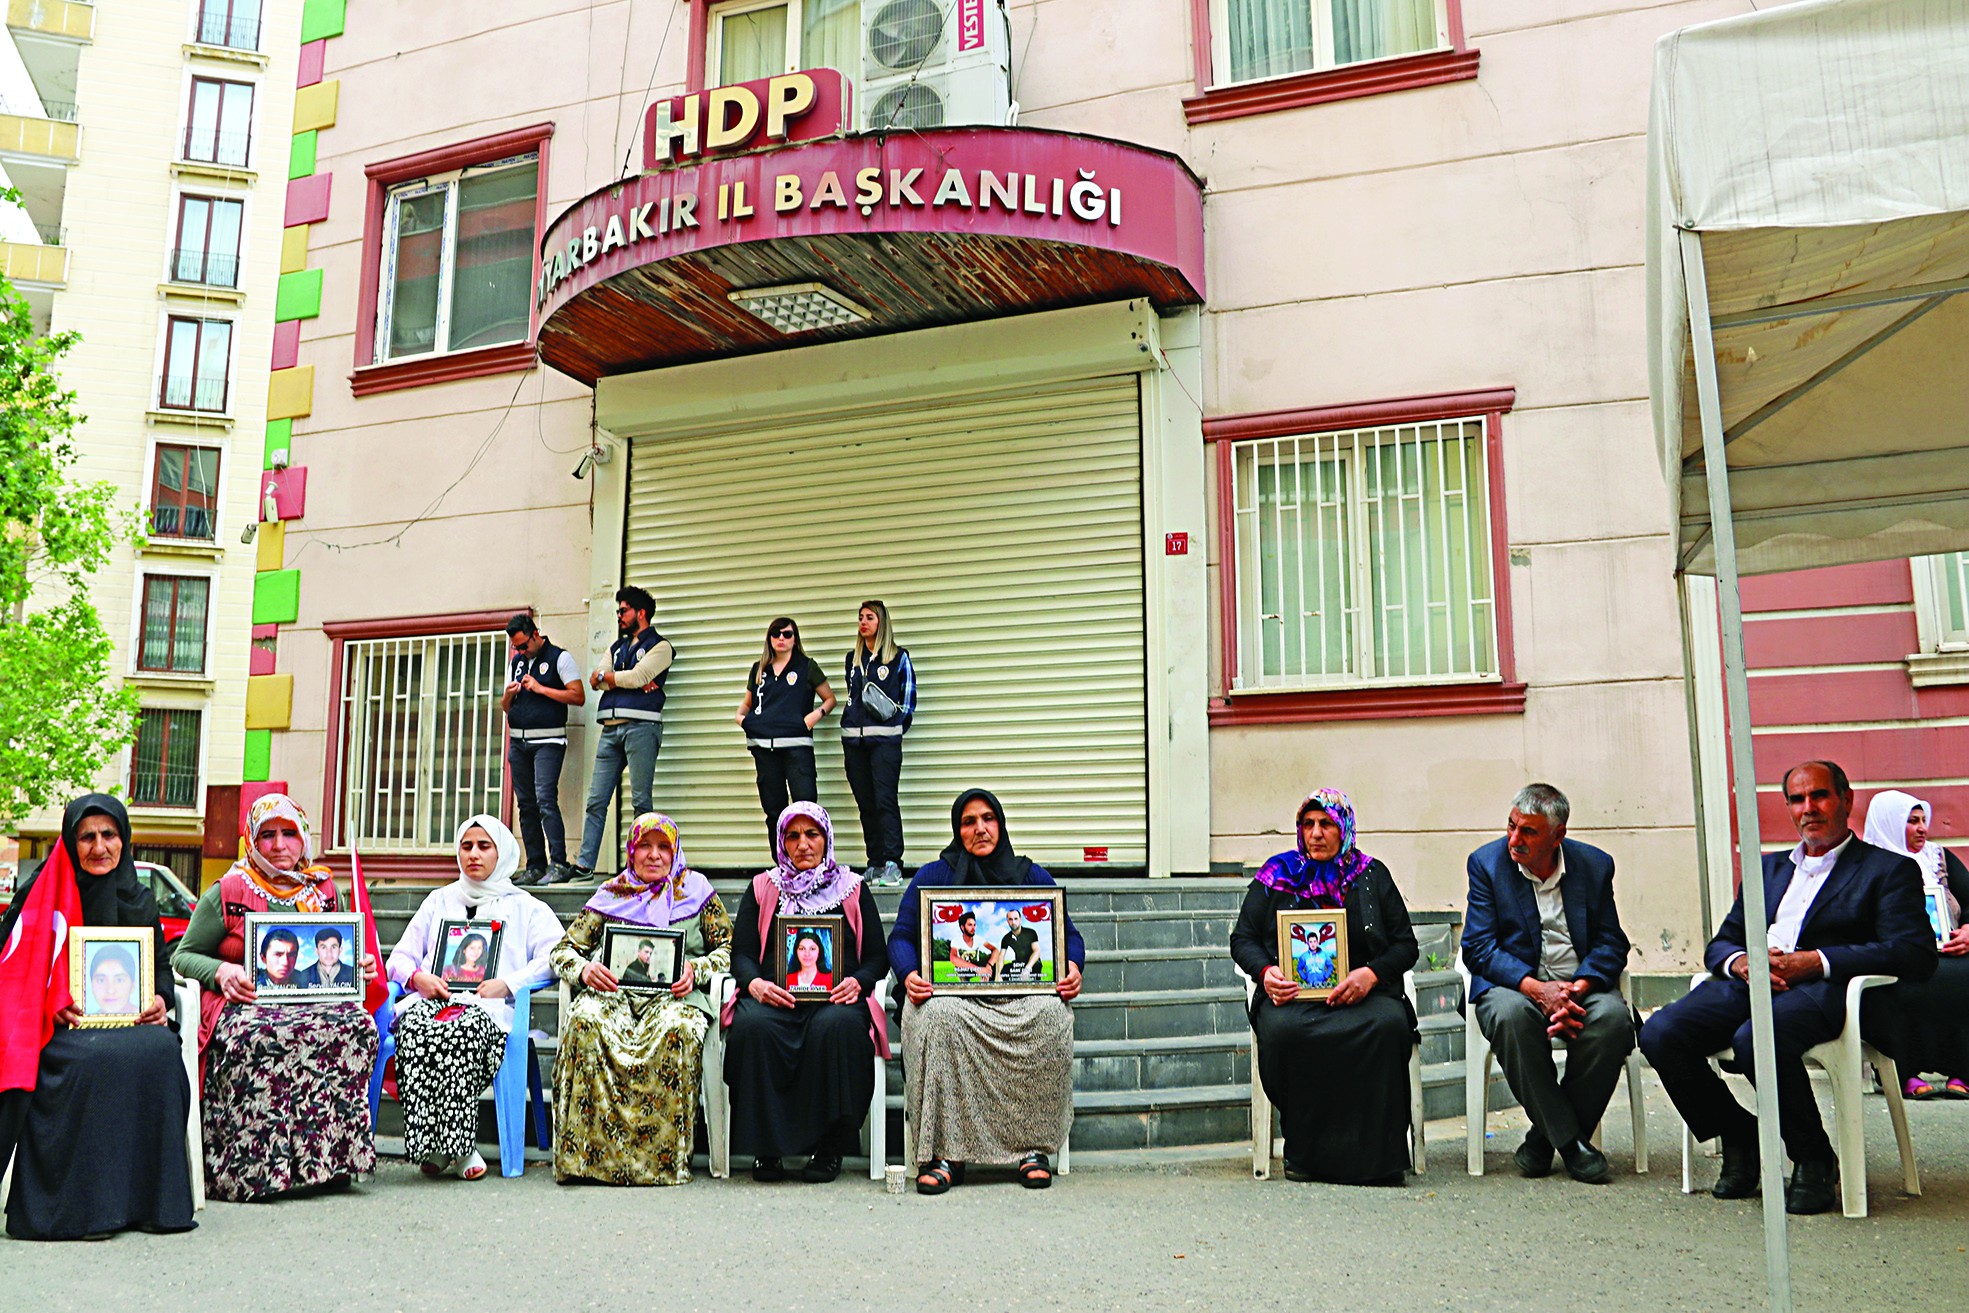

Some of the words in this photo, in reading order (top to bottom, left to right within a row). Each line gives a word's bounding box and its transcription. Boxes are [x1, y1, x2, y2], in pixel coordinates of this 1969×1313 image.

[655, 73, 817, 162] HDP
[775, 167, 1121, 226] BAŞKANLIĞI
[1172, 541, 1182, 551] 17
